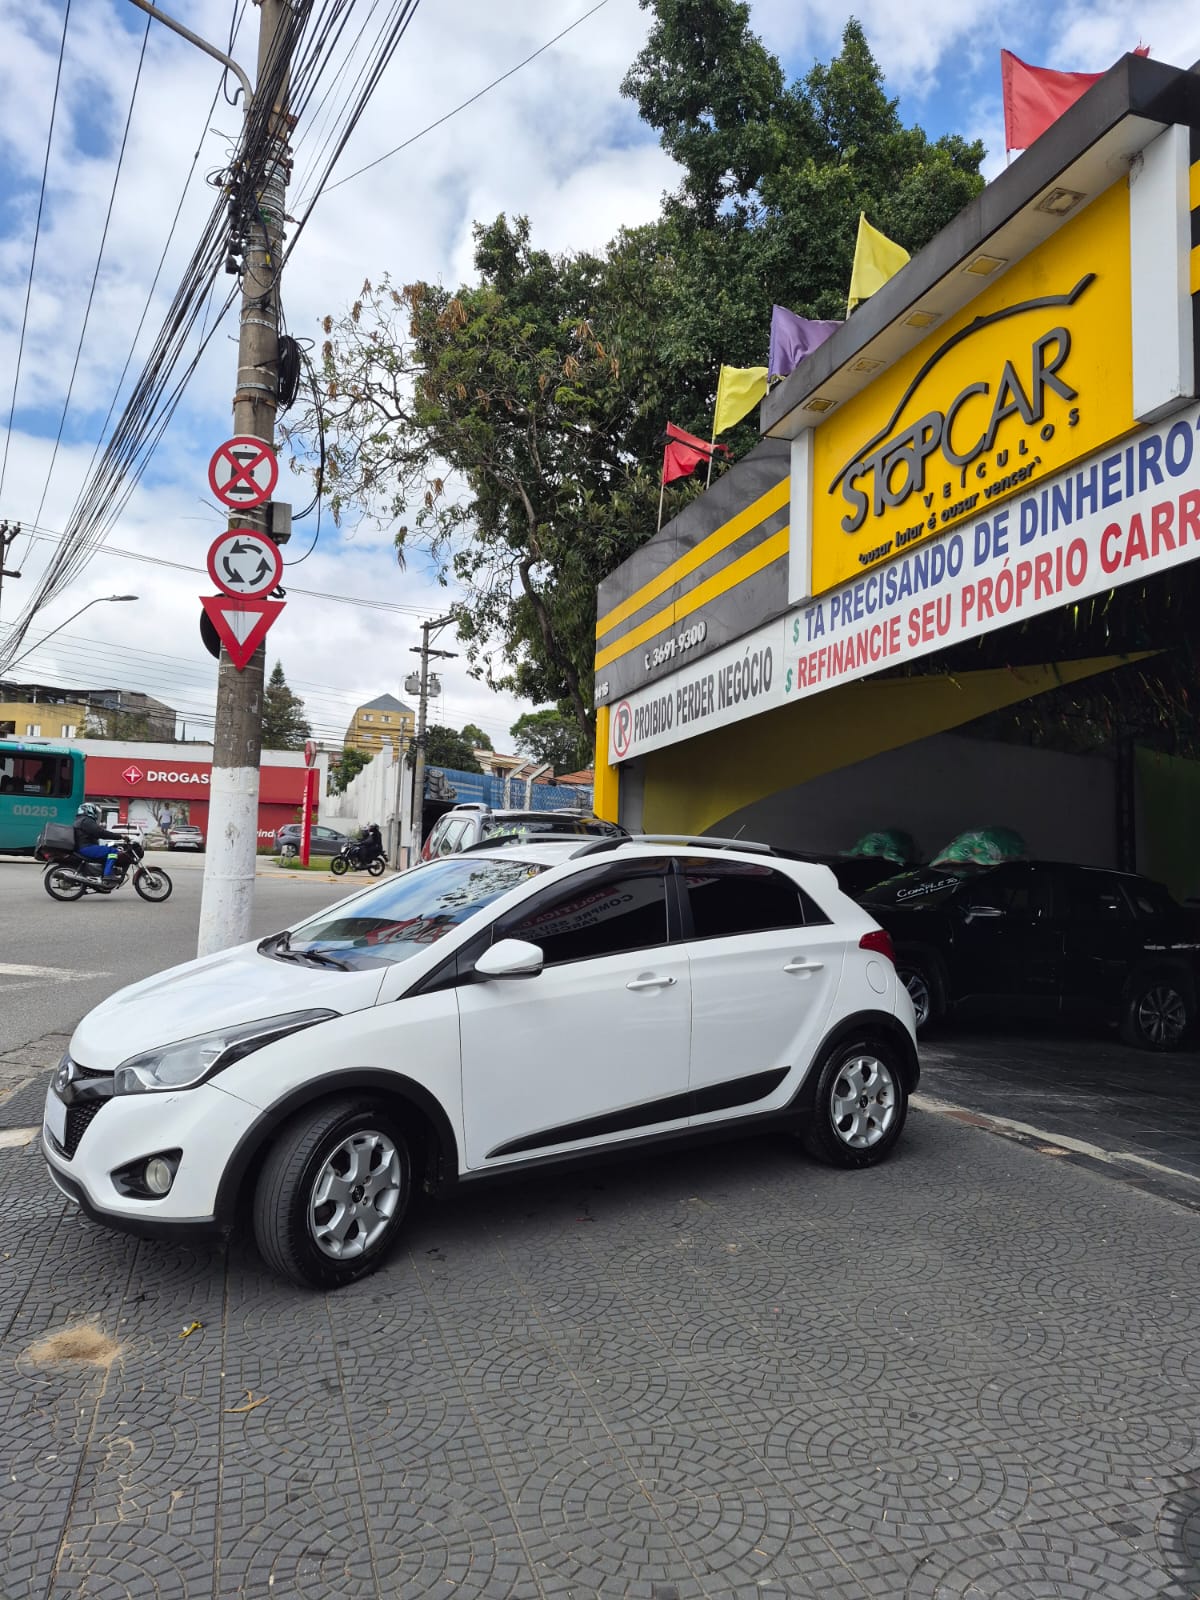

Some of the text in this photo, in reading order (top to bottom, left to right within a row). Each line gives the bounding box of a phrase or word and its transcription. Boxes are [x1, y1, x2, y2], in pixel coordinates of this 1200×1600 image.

[841, 326, 1079, 534] STOPCAR
[805, 604, 826, 642] TA
[830, 534, 964, 632] PRECISANDO
[974, 509, 1010, 567] DE
[1020, 414, 1200, 546] DINHEIRO
[895, 521, 924, 547] lutar
[927, 512, 936, 530] é
[941, 493, 980, 522] ousar
[797, 615, 901, 690] REFINANCIE
[907, 593, 952, 648] SEU
[961, 537, 1088, 628] PRÓPRIO
[652, 621, 707, 667] 3691-9300
[634, 693, 673, 743] PROIBIDO
[676, 674, 714, 727] PERDER
[718, 646, 773, 711] NEGÓCIO
[147, 770, 213, 785] DROGAS
[13, 804, 58, 817] 00263
[257, 829, 275, 838] ind
